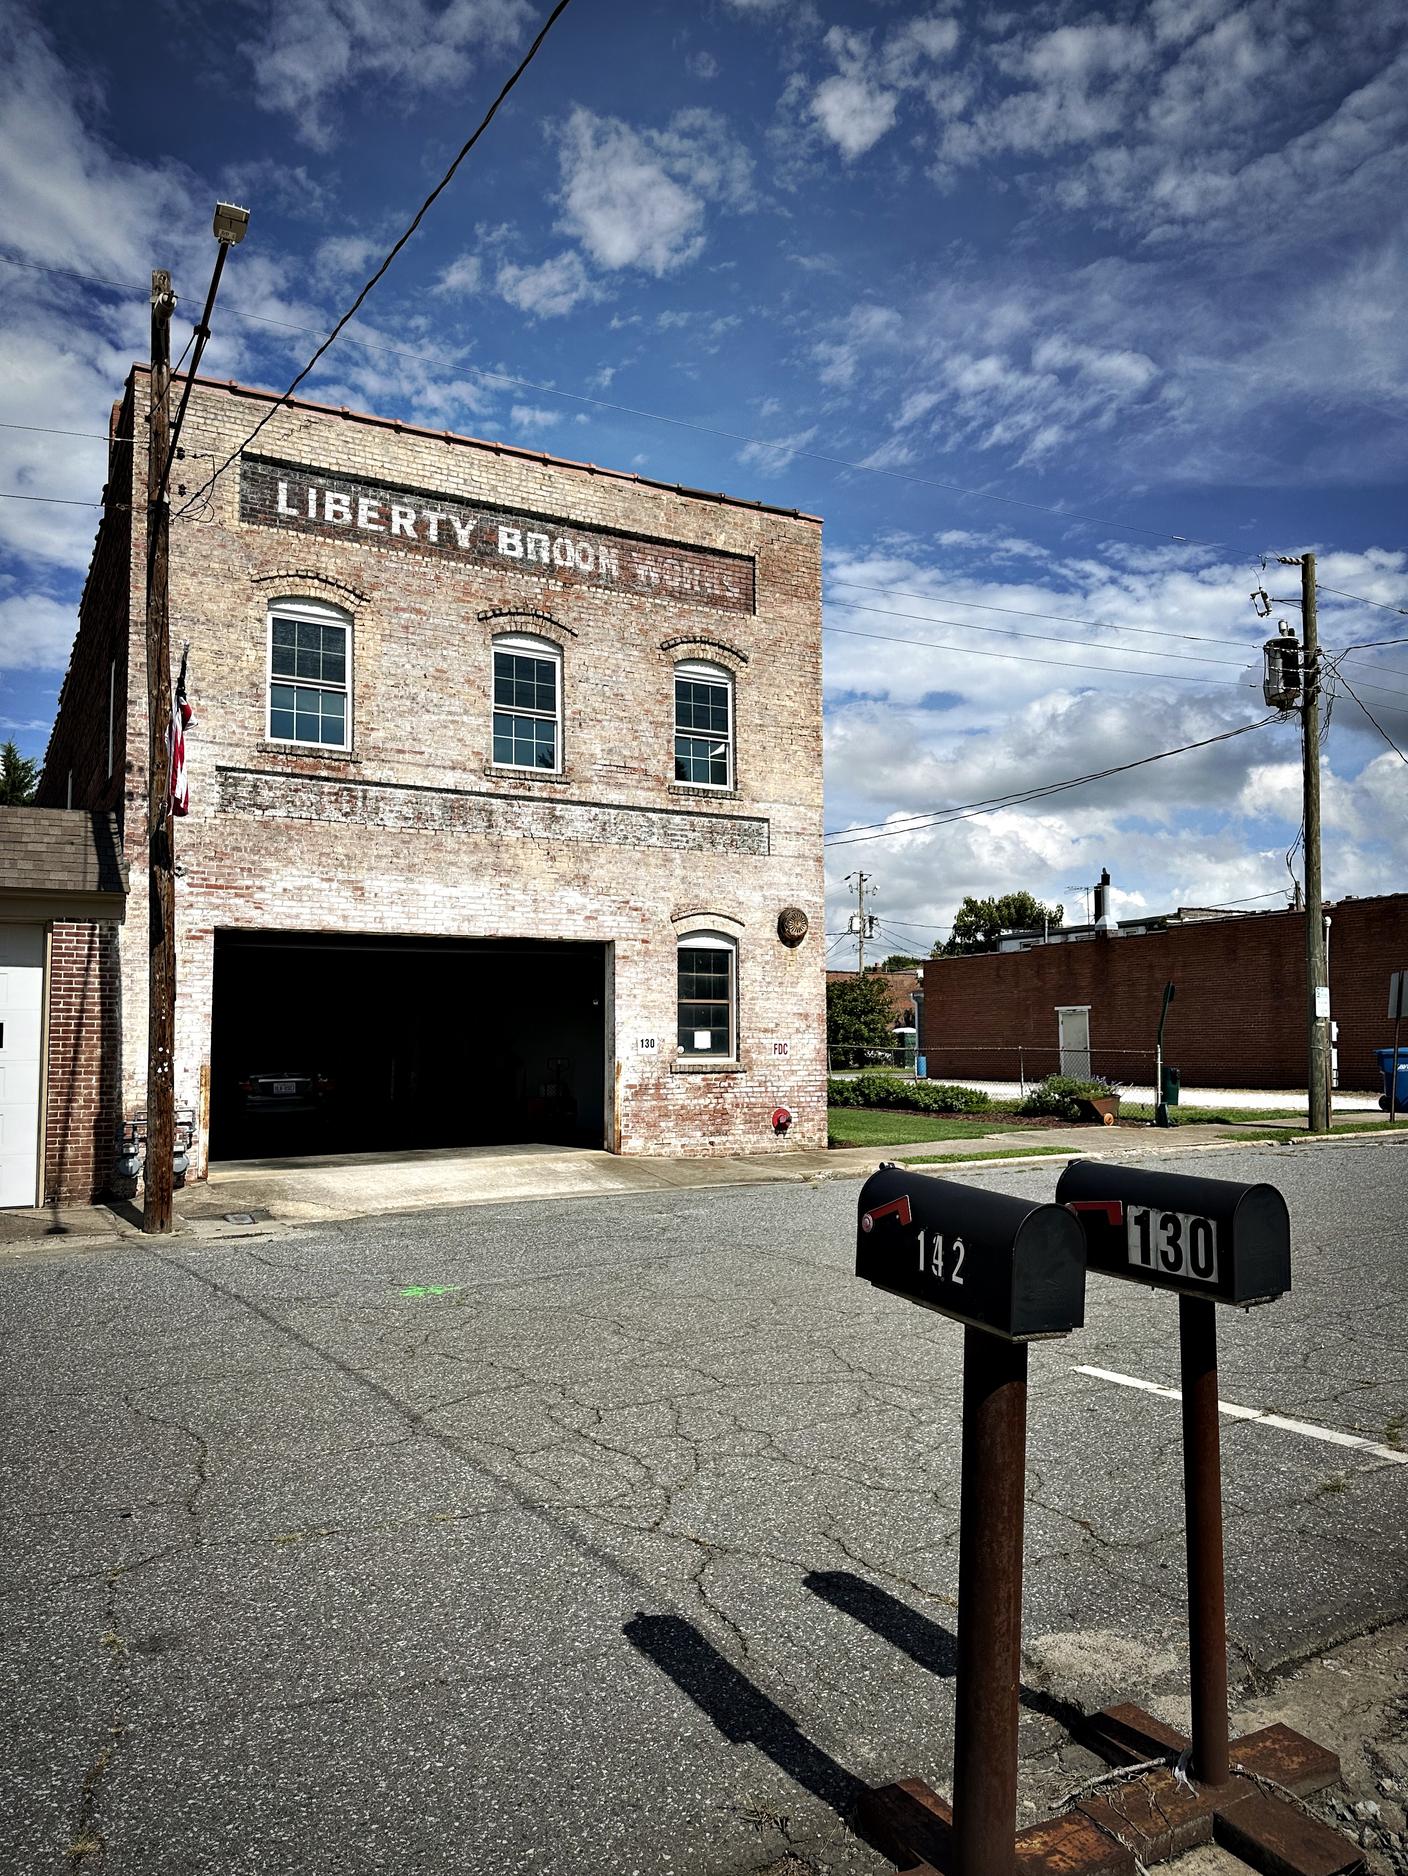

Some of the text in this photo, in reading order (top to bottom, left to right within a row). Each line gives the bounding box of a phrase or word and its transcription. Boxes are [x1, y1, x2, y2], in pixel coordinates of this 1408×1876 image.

[277, 481, 477, 548] LIBERTY
[640, 1038, 655, 1049] 130
[773, 1042, 789, 1056] FDC
[917, 1229, 965, 1285] 142
[1133, 1208, 1215, 1281] 130
